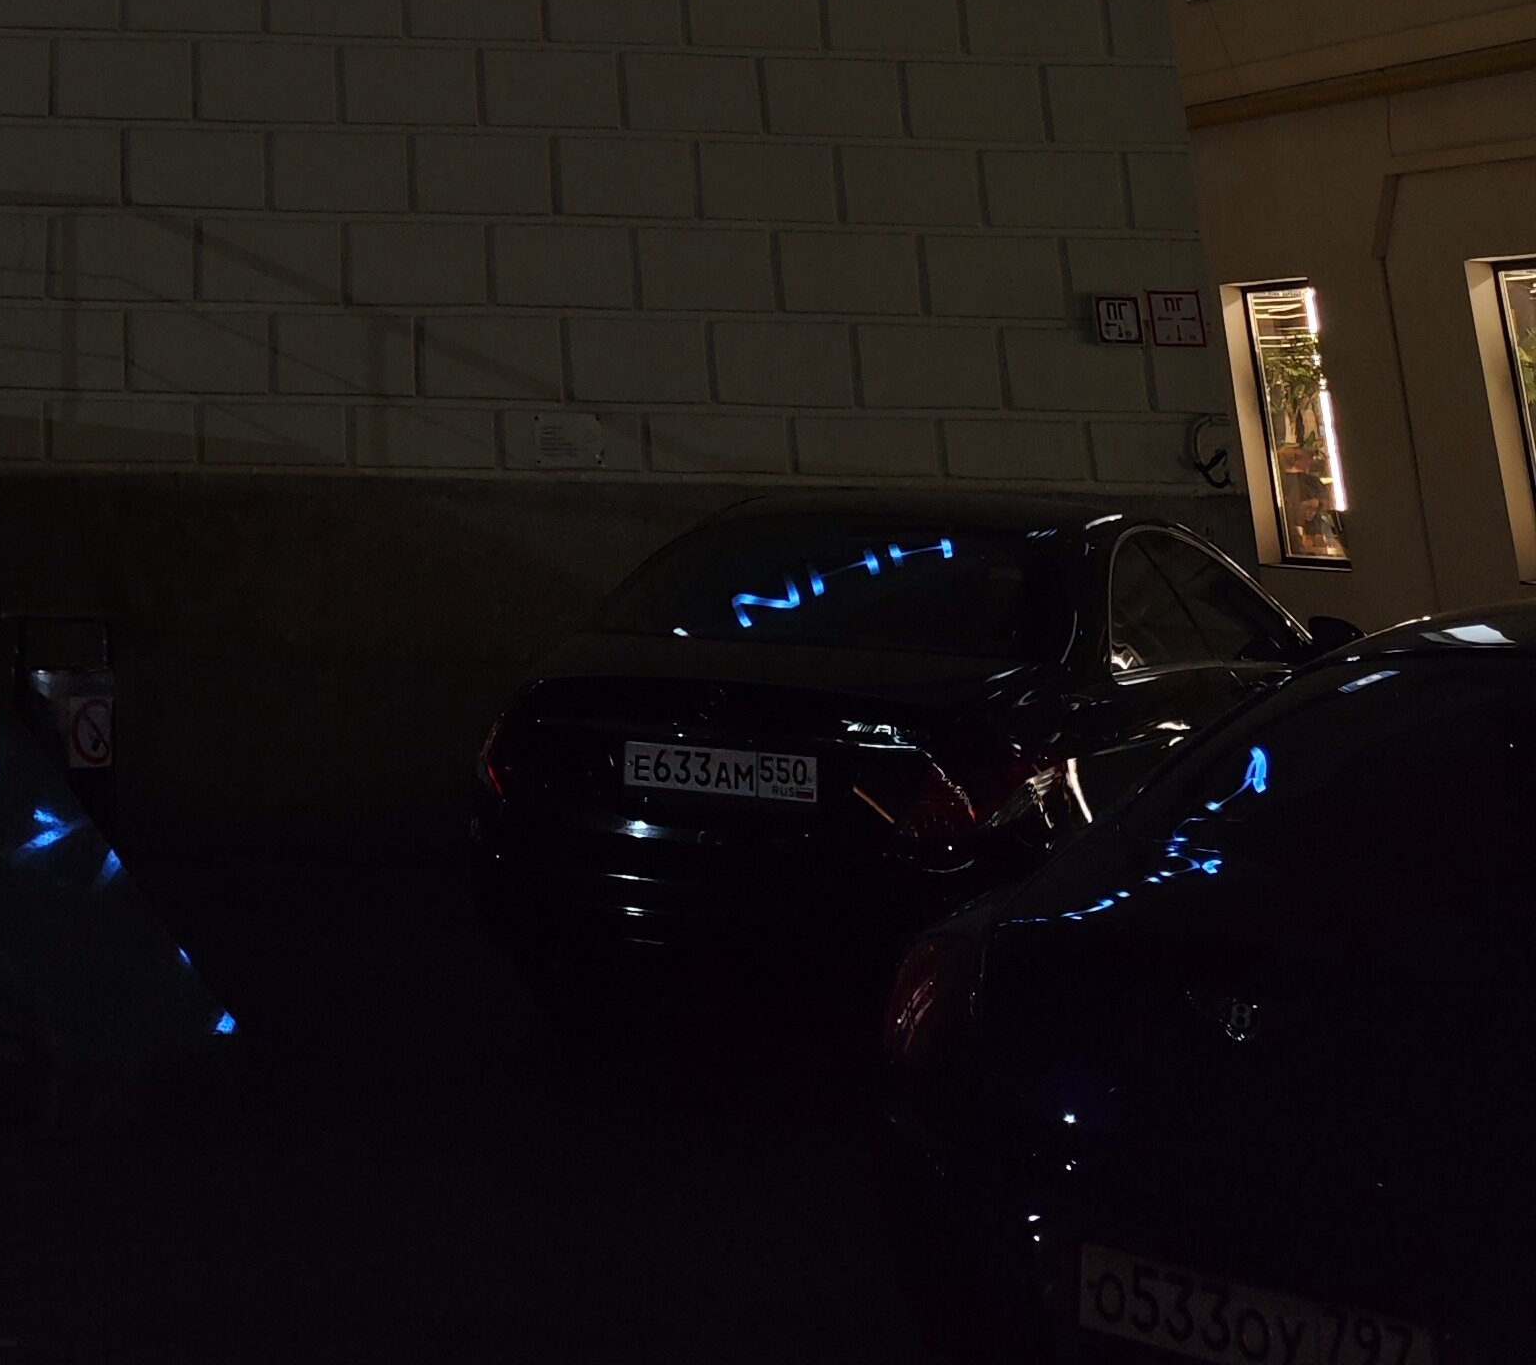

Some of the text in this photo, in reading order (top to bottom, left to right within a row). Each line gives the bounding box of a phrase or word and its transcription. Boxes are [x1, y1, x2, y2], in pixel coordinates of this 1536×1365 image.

[1106, 302, 1127, 320] ПГ
[1164, 297, 1183, 312] ПГ
[772, 787, 796, 799] RUS
